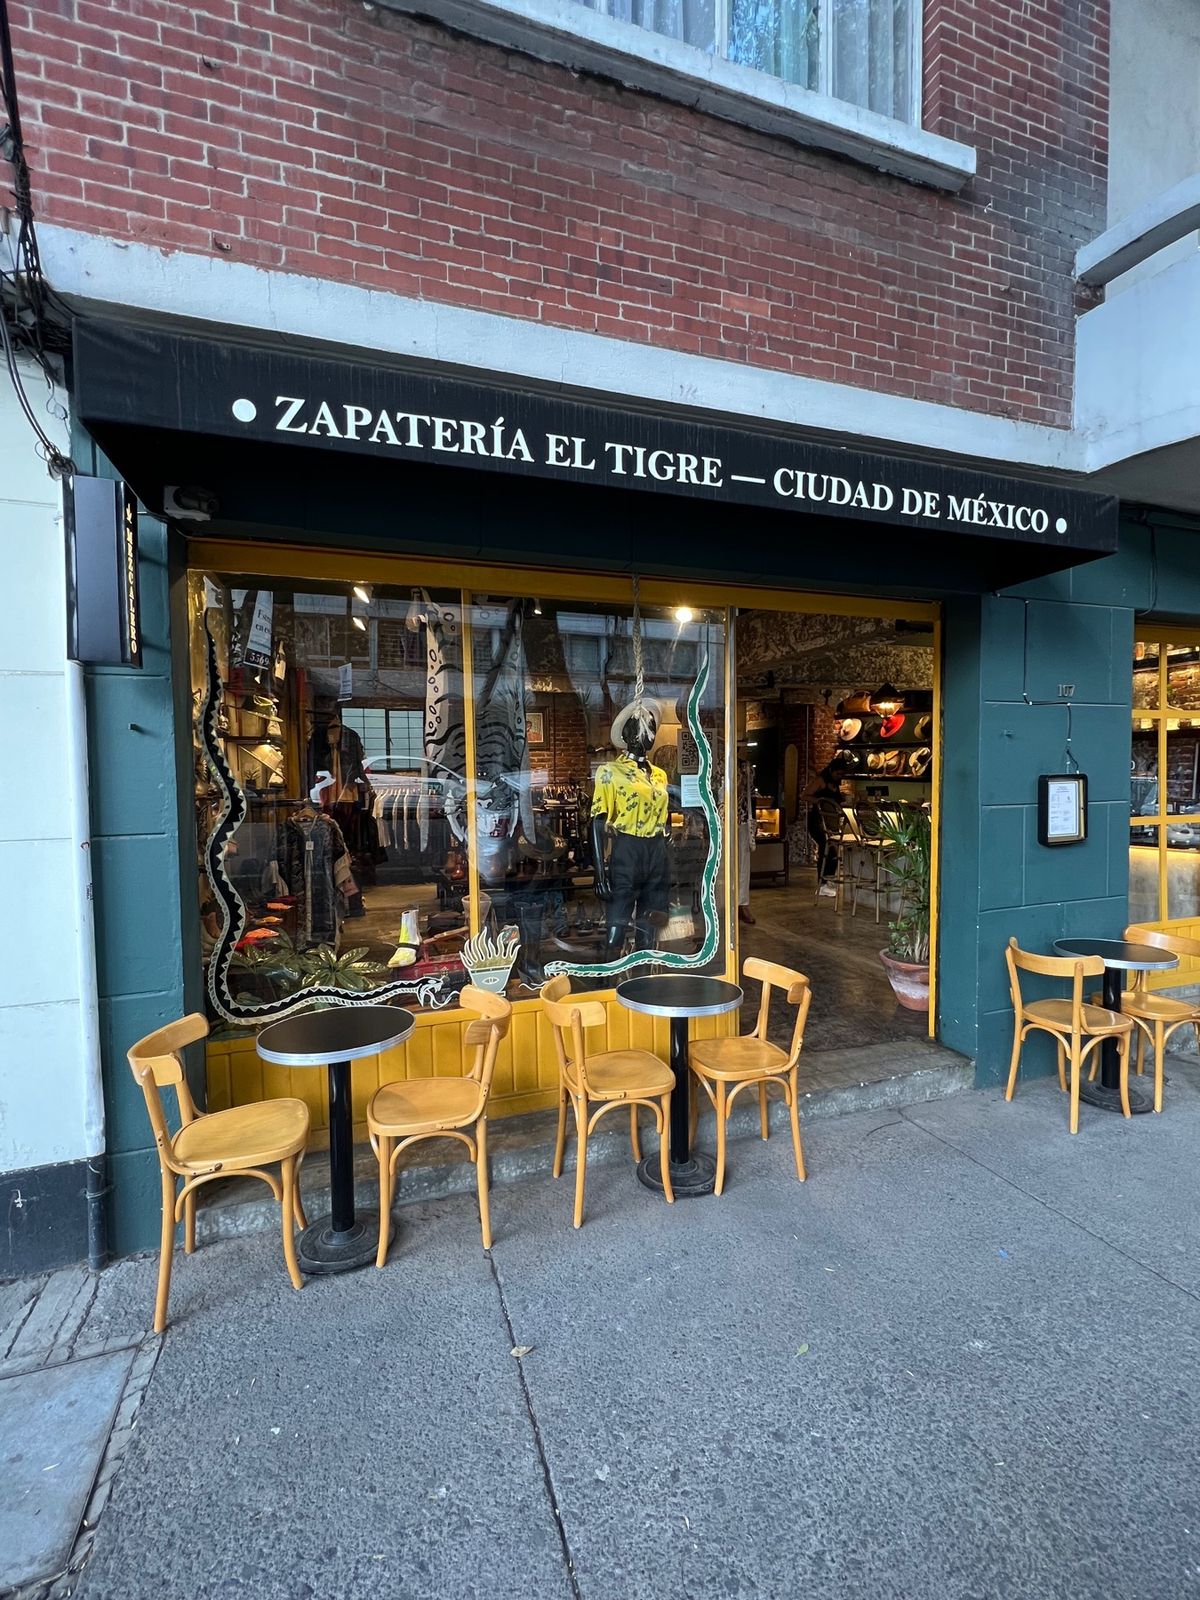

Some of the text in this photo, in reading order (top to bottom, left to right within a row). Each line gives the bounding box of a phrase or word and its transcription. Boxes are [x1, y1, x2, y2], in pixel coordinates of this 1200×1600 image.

[275, 396, 535, 462] ZAPATERÍA
[545, 433, 596, 470] EL
[604, 442, 724, 487] TIGRE
[773, 467, 894, 511] CIUDAD
[900, 488, 940, 518] DE
[947, 493, 1049, 533] MÉXICO
[1057, 684, 1076, 698] 107
